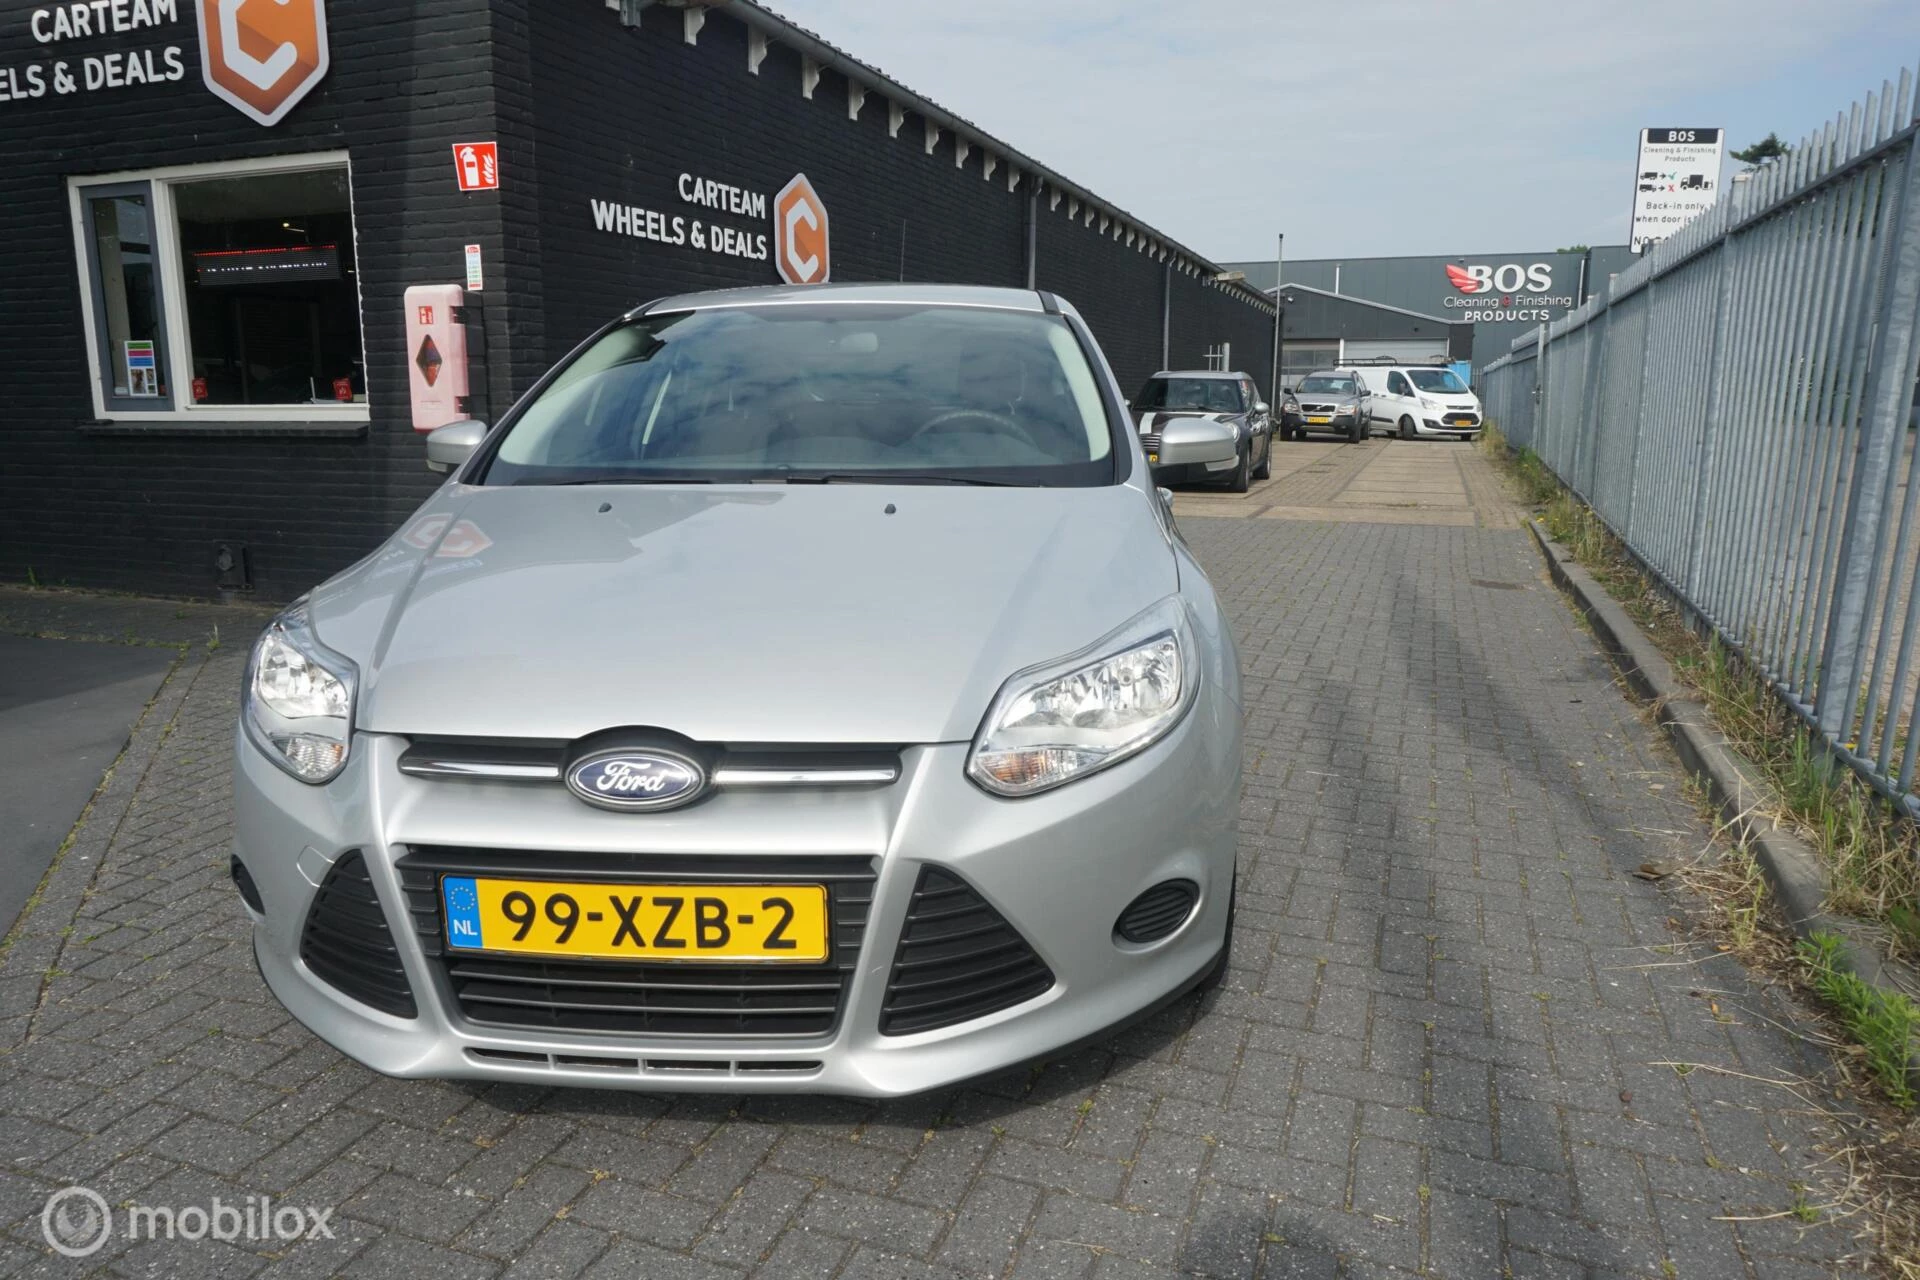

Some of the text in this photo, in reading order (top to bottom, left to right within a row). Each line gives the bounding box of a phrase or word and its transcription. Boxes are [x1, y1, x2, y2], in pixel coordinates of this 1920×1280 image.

[31, 0, 178, 43] CARTEAM
[53, 61, 77, 95] &
[83, 46, 185, 91] DEALS
[1668, 130, 1696, 142] BOS
[678, 172, 766, 220] CARTEAM
[1646, 201, 1705, 211] Back-in only
[590, 198, 767, 260] WHEELS & DEALS
[1635, 215, 1659, 223] when
[1661, 215, 1681, 223] door
[1684, 215, 1692, 223] is
[1467, 263, 1552, 294] BOS
[1443, 294, 1572, 309] Cleaning & Finishing
[1464, 309, 1550, 322] PRODUCTS
[597, 760, 669, 792] Ford
[453, 889, 797, 950] NL 99-XZB-2
